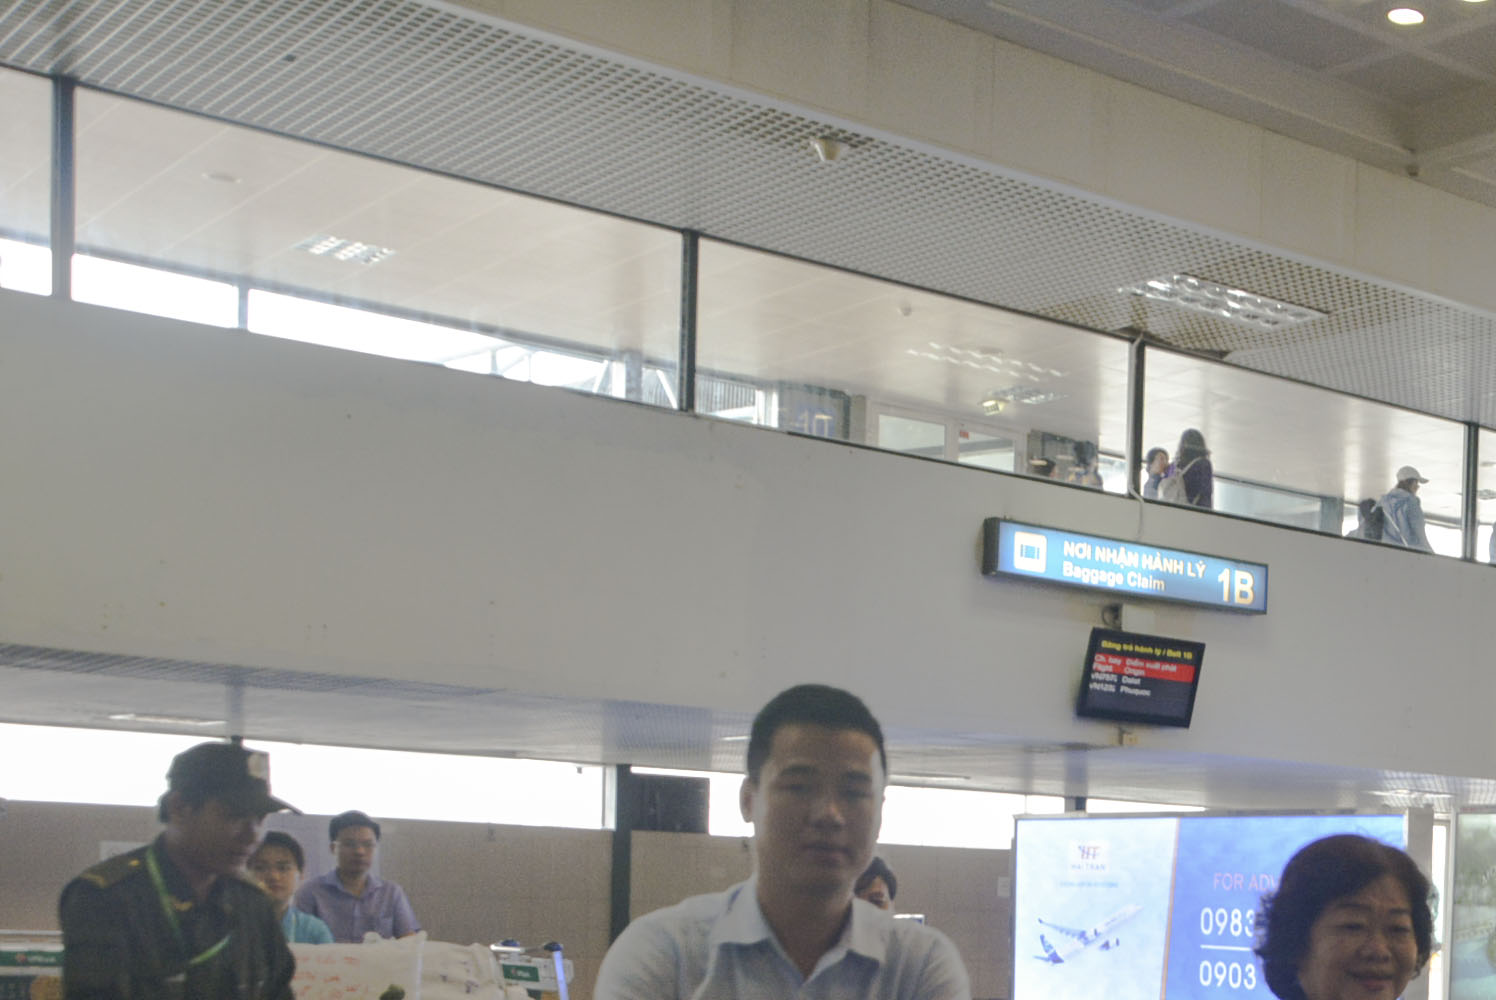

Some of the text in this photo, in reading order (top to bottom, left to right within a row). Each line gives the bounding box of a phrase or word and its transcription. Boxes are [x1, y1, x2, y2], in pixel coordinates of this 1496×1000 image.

[1063, 540, 1206, 579] NƠI NHẬN HÀNH LÝ
[1063, 561, 1165, 592] Baggage Claim
[1217, 568, 1255, 605] 1B
[1213, 872, 1245, 891] FOR
[1199, 960, 1257, 990] 0903
